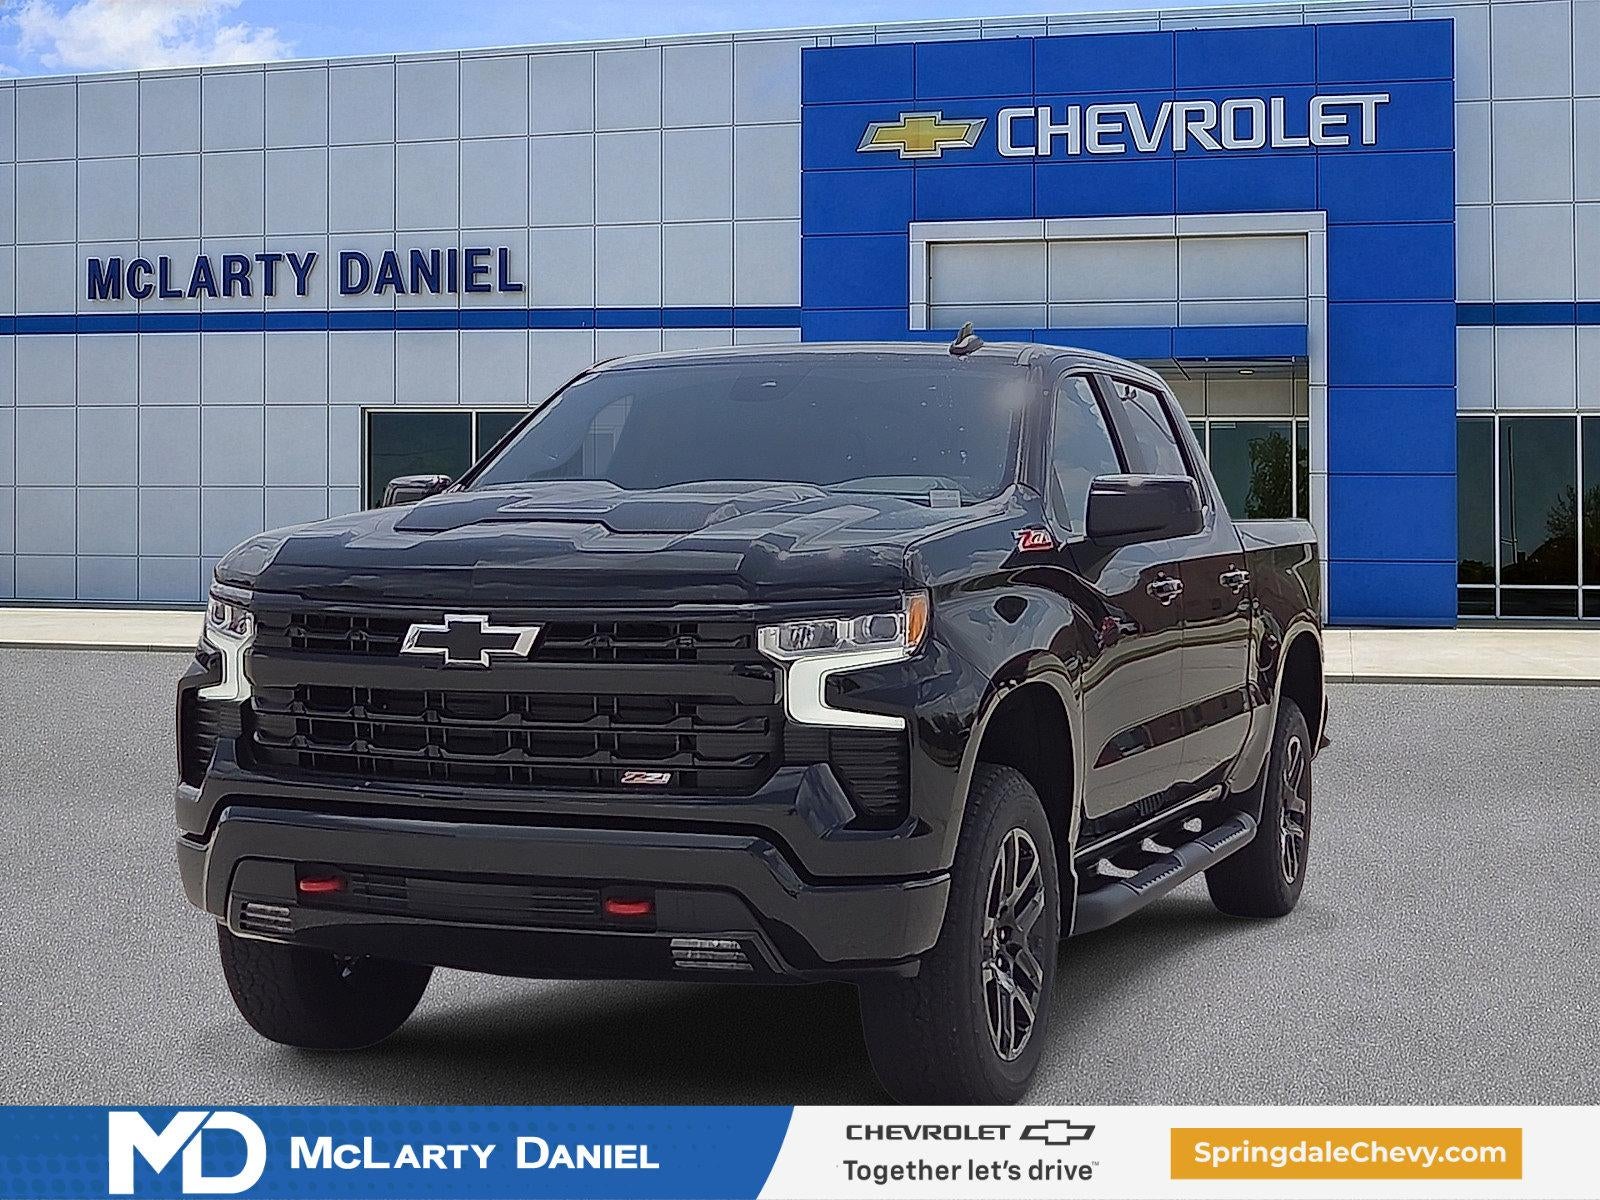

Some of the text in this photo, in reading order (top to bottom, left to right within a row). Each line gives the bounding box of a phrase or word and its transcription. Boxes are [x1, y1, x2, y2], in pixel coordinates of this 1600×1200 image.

[997, 93, 1390, 157] CHEVROLET
[87, 246, 523, 300] MCLARTY DANIEL
